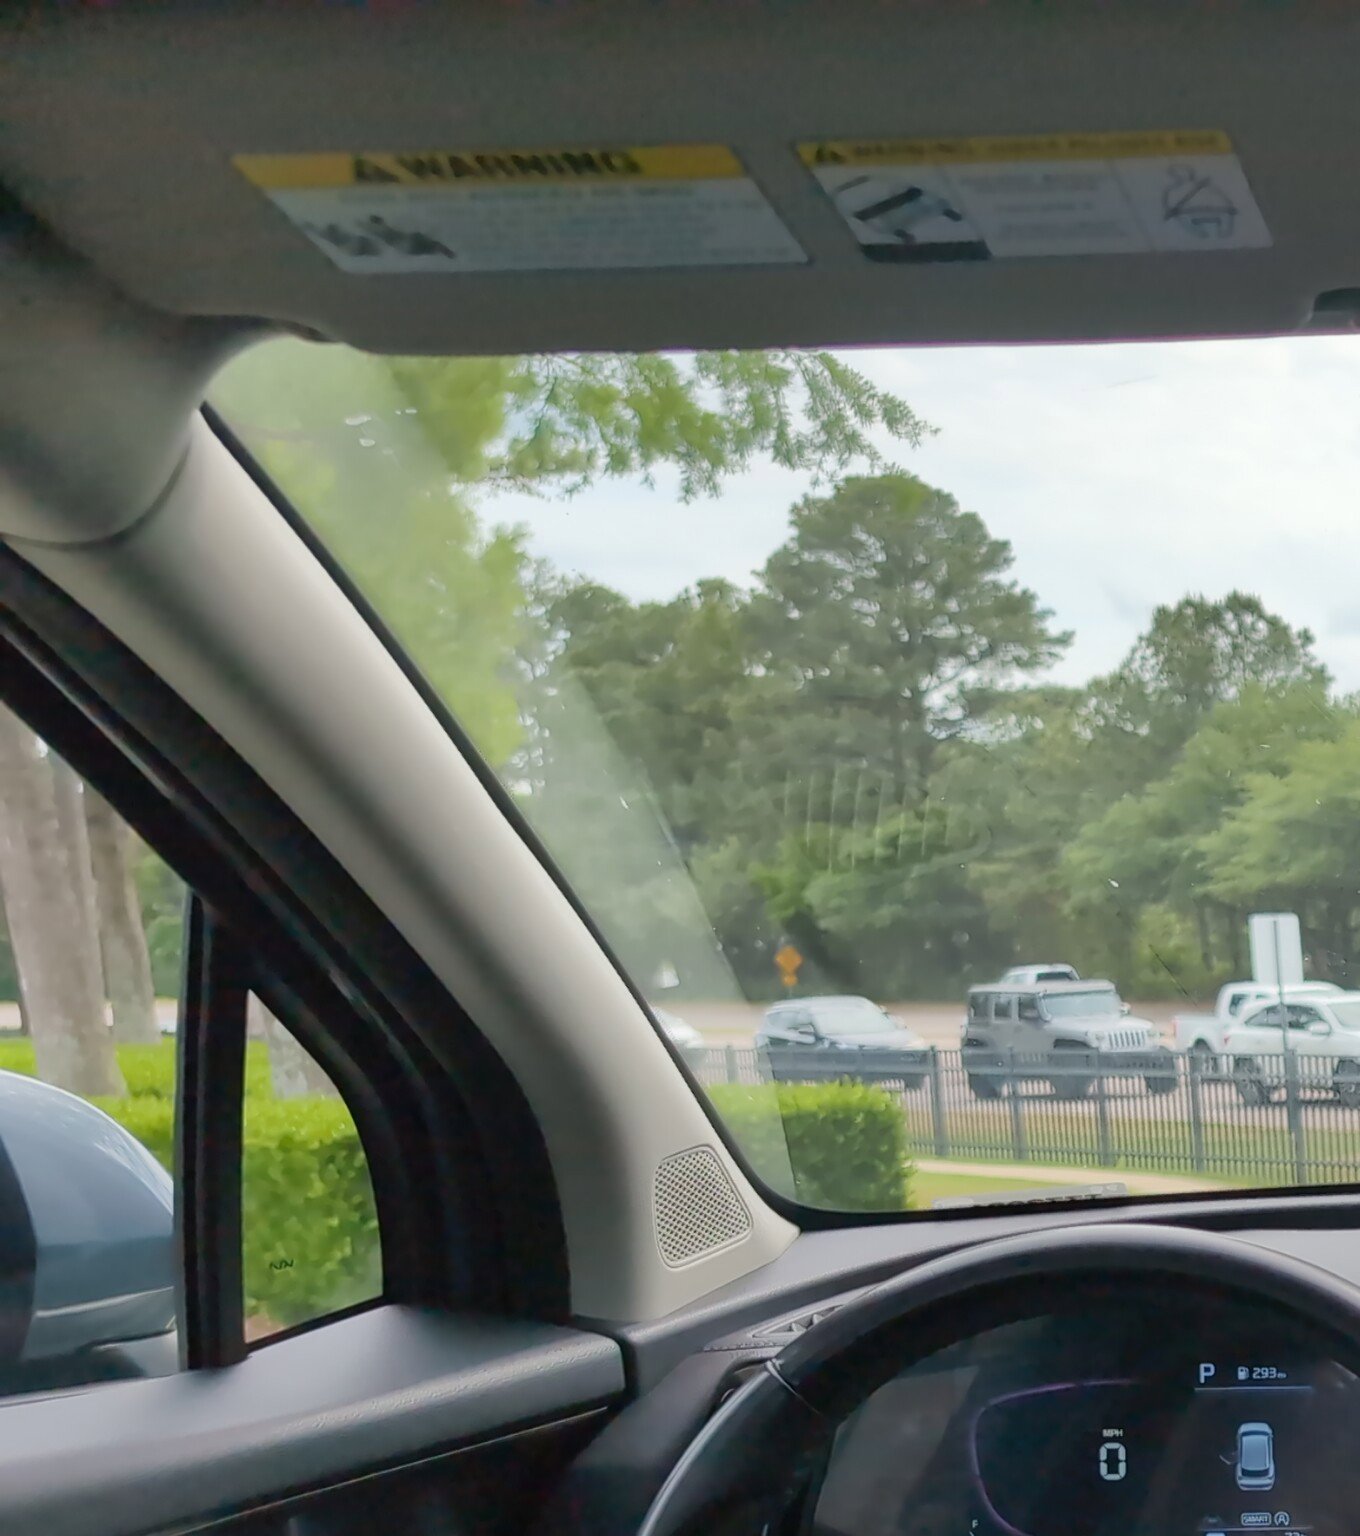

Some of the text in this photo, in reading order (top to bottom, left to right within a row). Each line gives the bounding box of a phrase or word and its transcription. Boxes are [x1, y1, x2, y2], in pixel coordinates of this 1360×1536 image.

[398, 150, 642, 180] WARNING
[1200, 1363, 1215, 1384] P
[1102, 1428, 1123, 1438] MPH
[1099, 1441, 1127, 1481] 0
[972, 1519, 979, 1528] F
